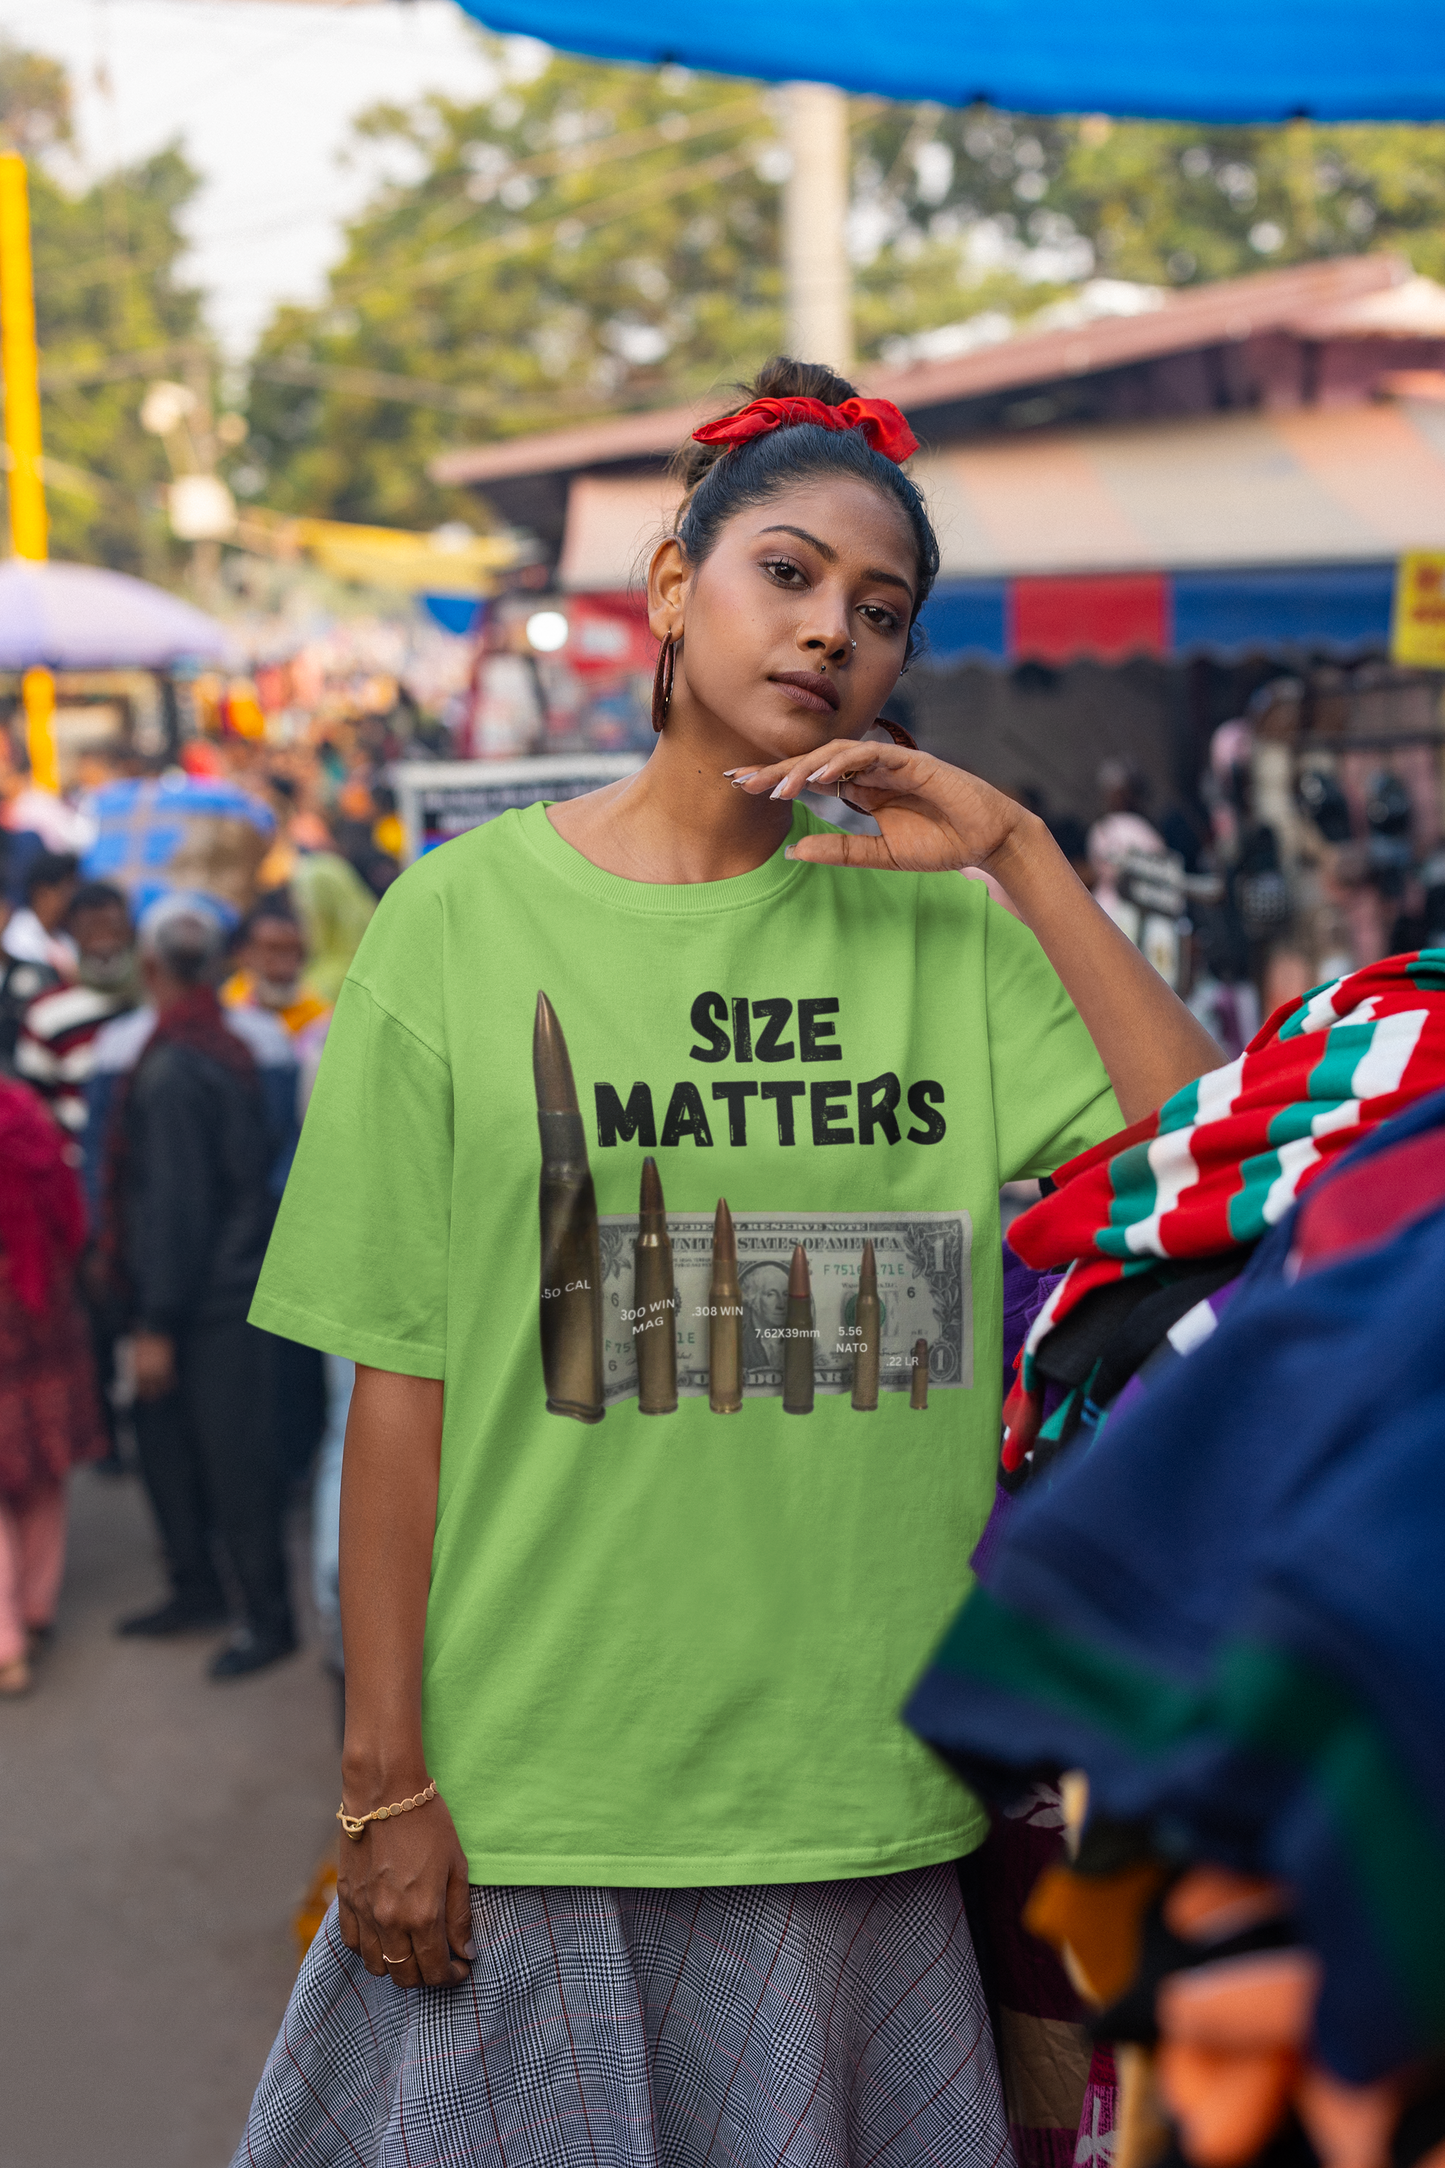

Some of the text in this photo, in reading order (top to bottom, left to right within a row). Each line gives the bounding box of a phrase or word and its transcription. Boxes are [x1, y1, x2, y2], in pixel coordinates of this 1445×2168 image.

[689, 991, 843, 1062] SIZE
[594, 1071, 947, 1147] MATTERS
[737, 1237, 799, 1250] STATES
[802, 1237, 824, 1249] OF
[541, 1279, 592, 1299] .50 CAL
[907, 1286, 916, 1298] 6
[611, 1292, 619, 1307] 6
[620, 1298, 676, 1321] 300 WIN
[691, 1306, 744, 1317] .308 WIN
[632, 1316, 664, 1335] MAG
[838, 1326, 863, 1337] 5.56
[754, 1328, 820, 1339] 7.62X39mm
[836, 1342, 868, 1353] NATO
[608, 1359, 618, 1372] 6
[886, 1356, 919, 1367] .22 LR
